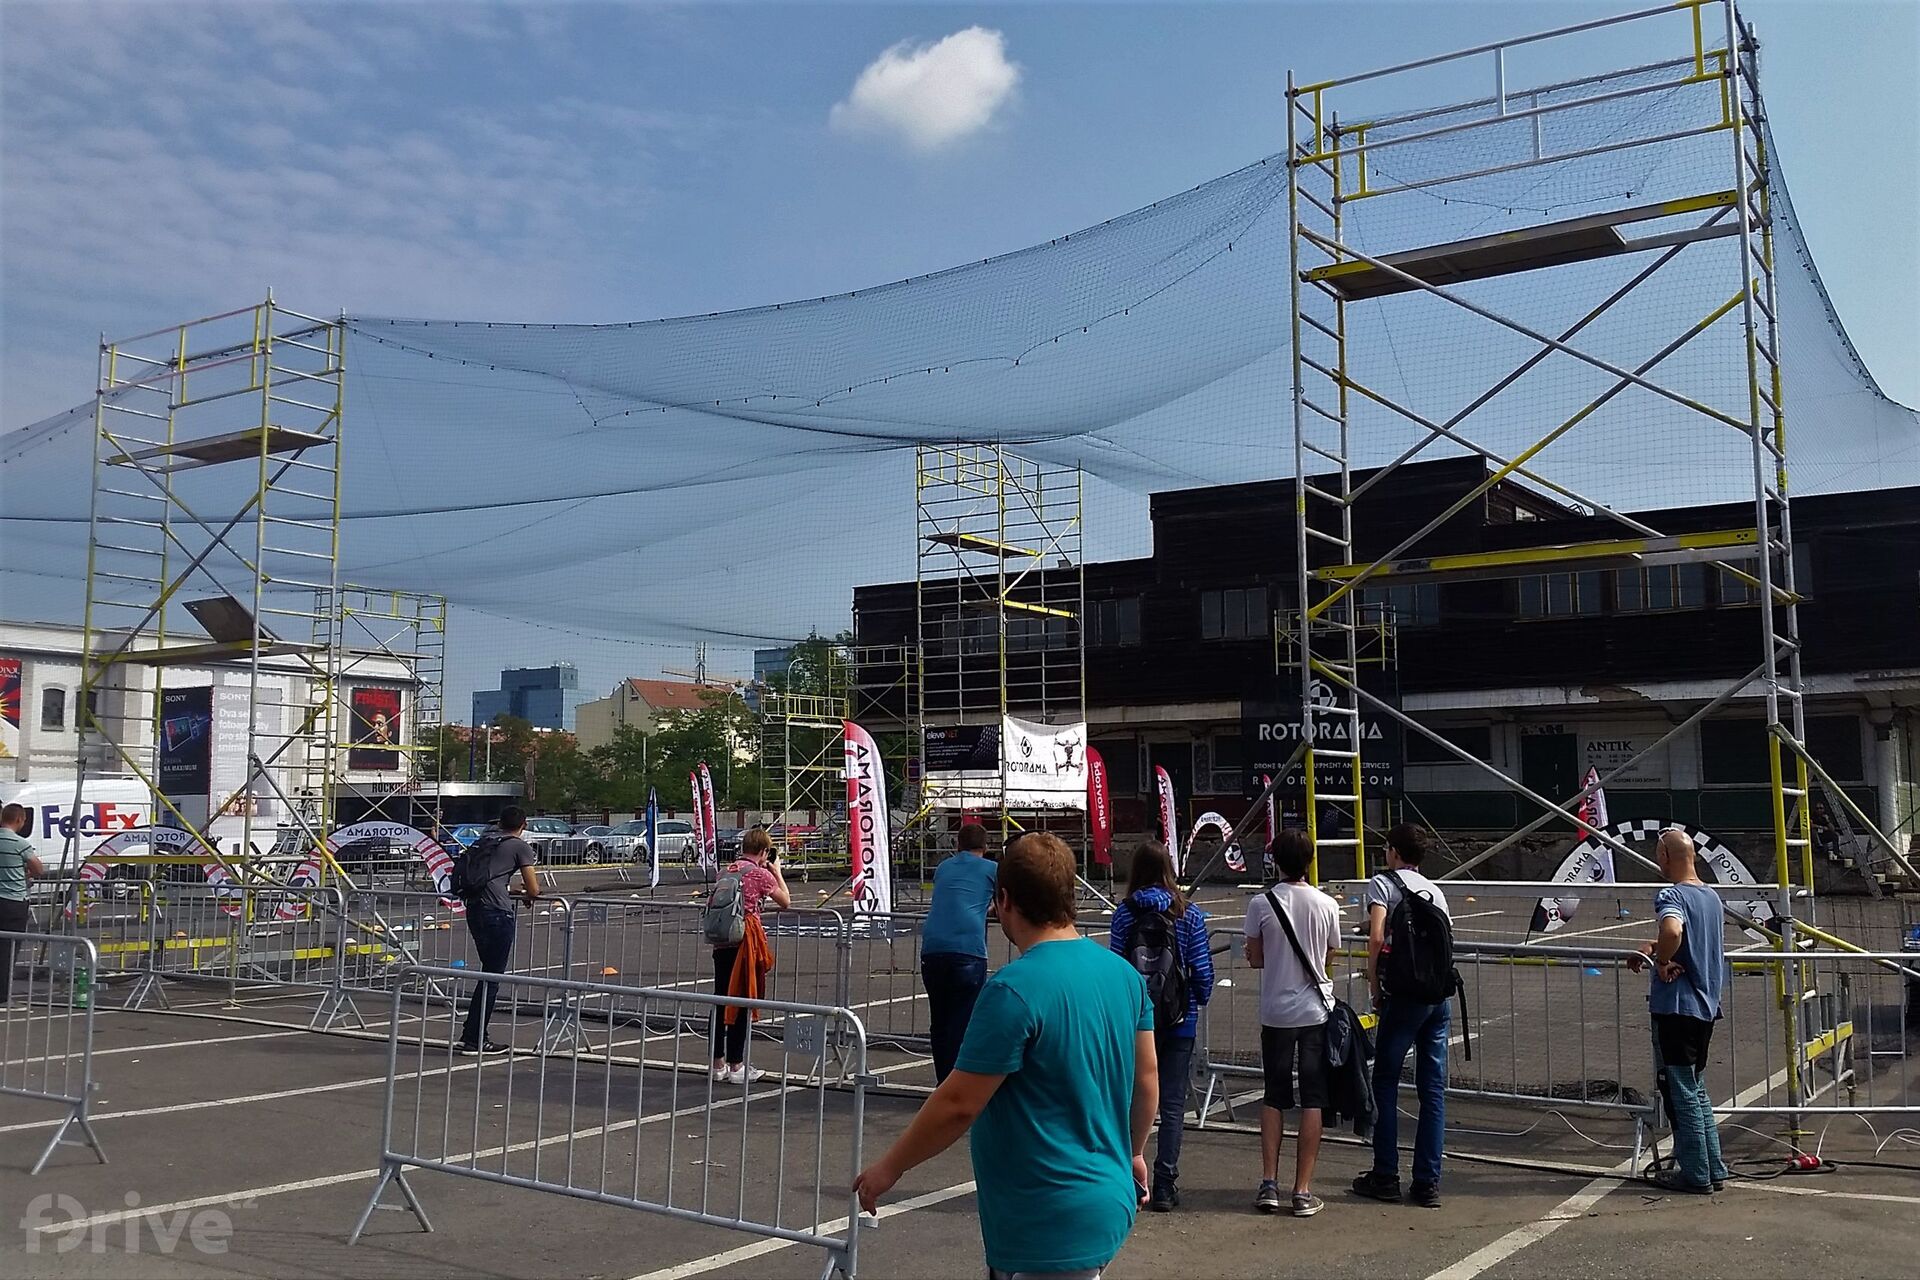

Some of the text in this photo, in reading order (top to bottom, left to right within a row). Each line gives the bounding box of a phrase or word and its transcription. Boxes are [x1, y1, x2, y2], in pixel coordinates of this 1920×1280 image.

[165, 694, 187, 703] SONY
[220, 693, 249, 701] SONY
[1587, 740, 1633, 752] ANTIK
[41, 802, 141, 839] FedEx
